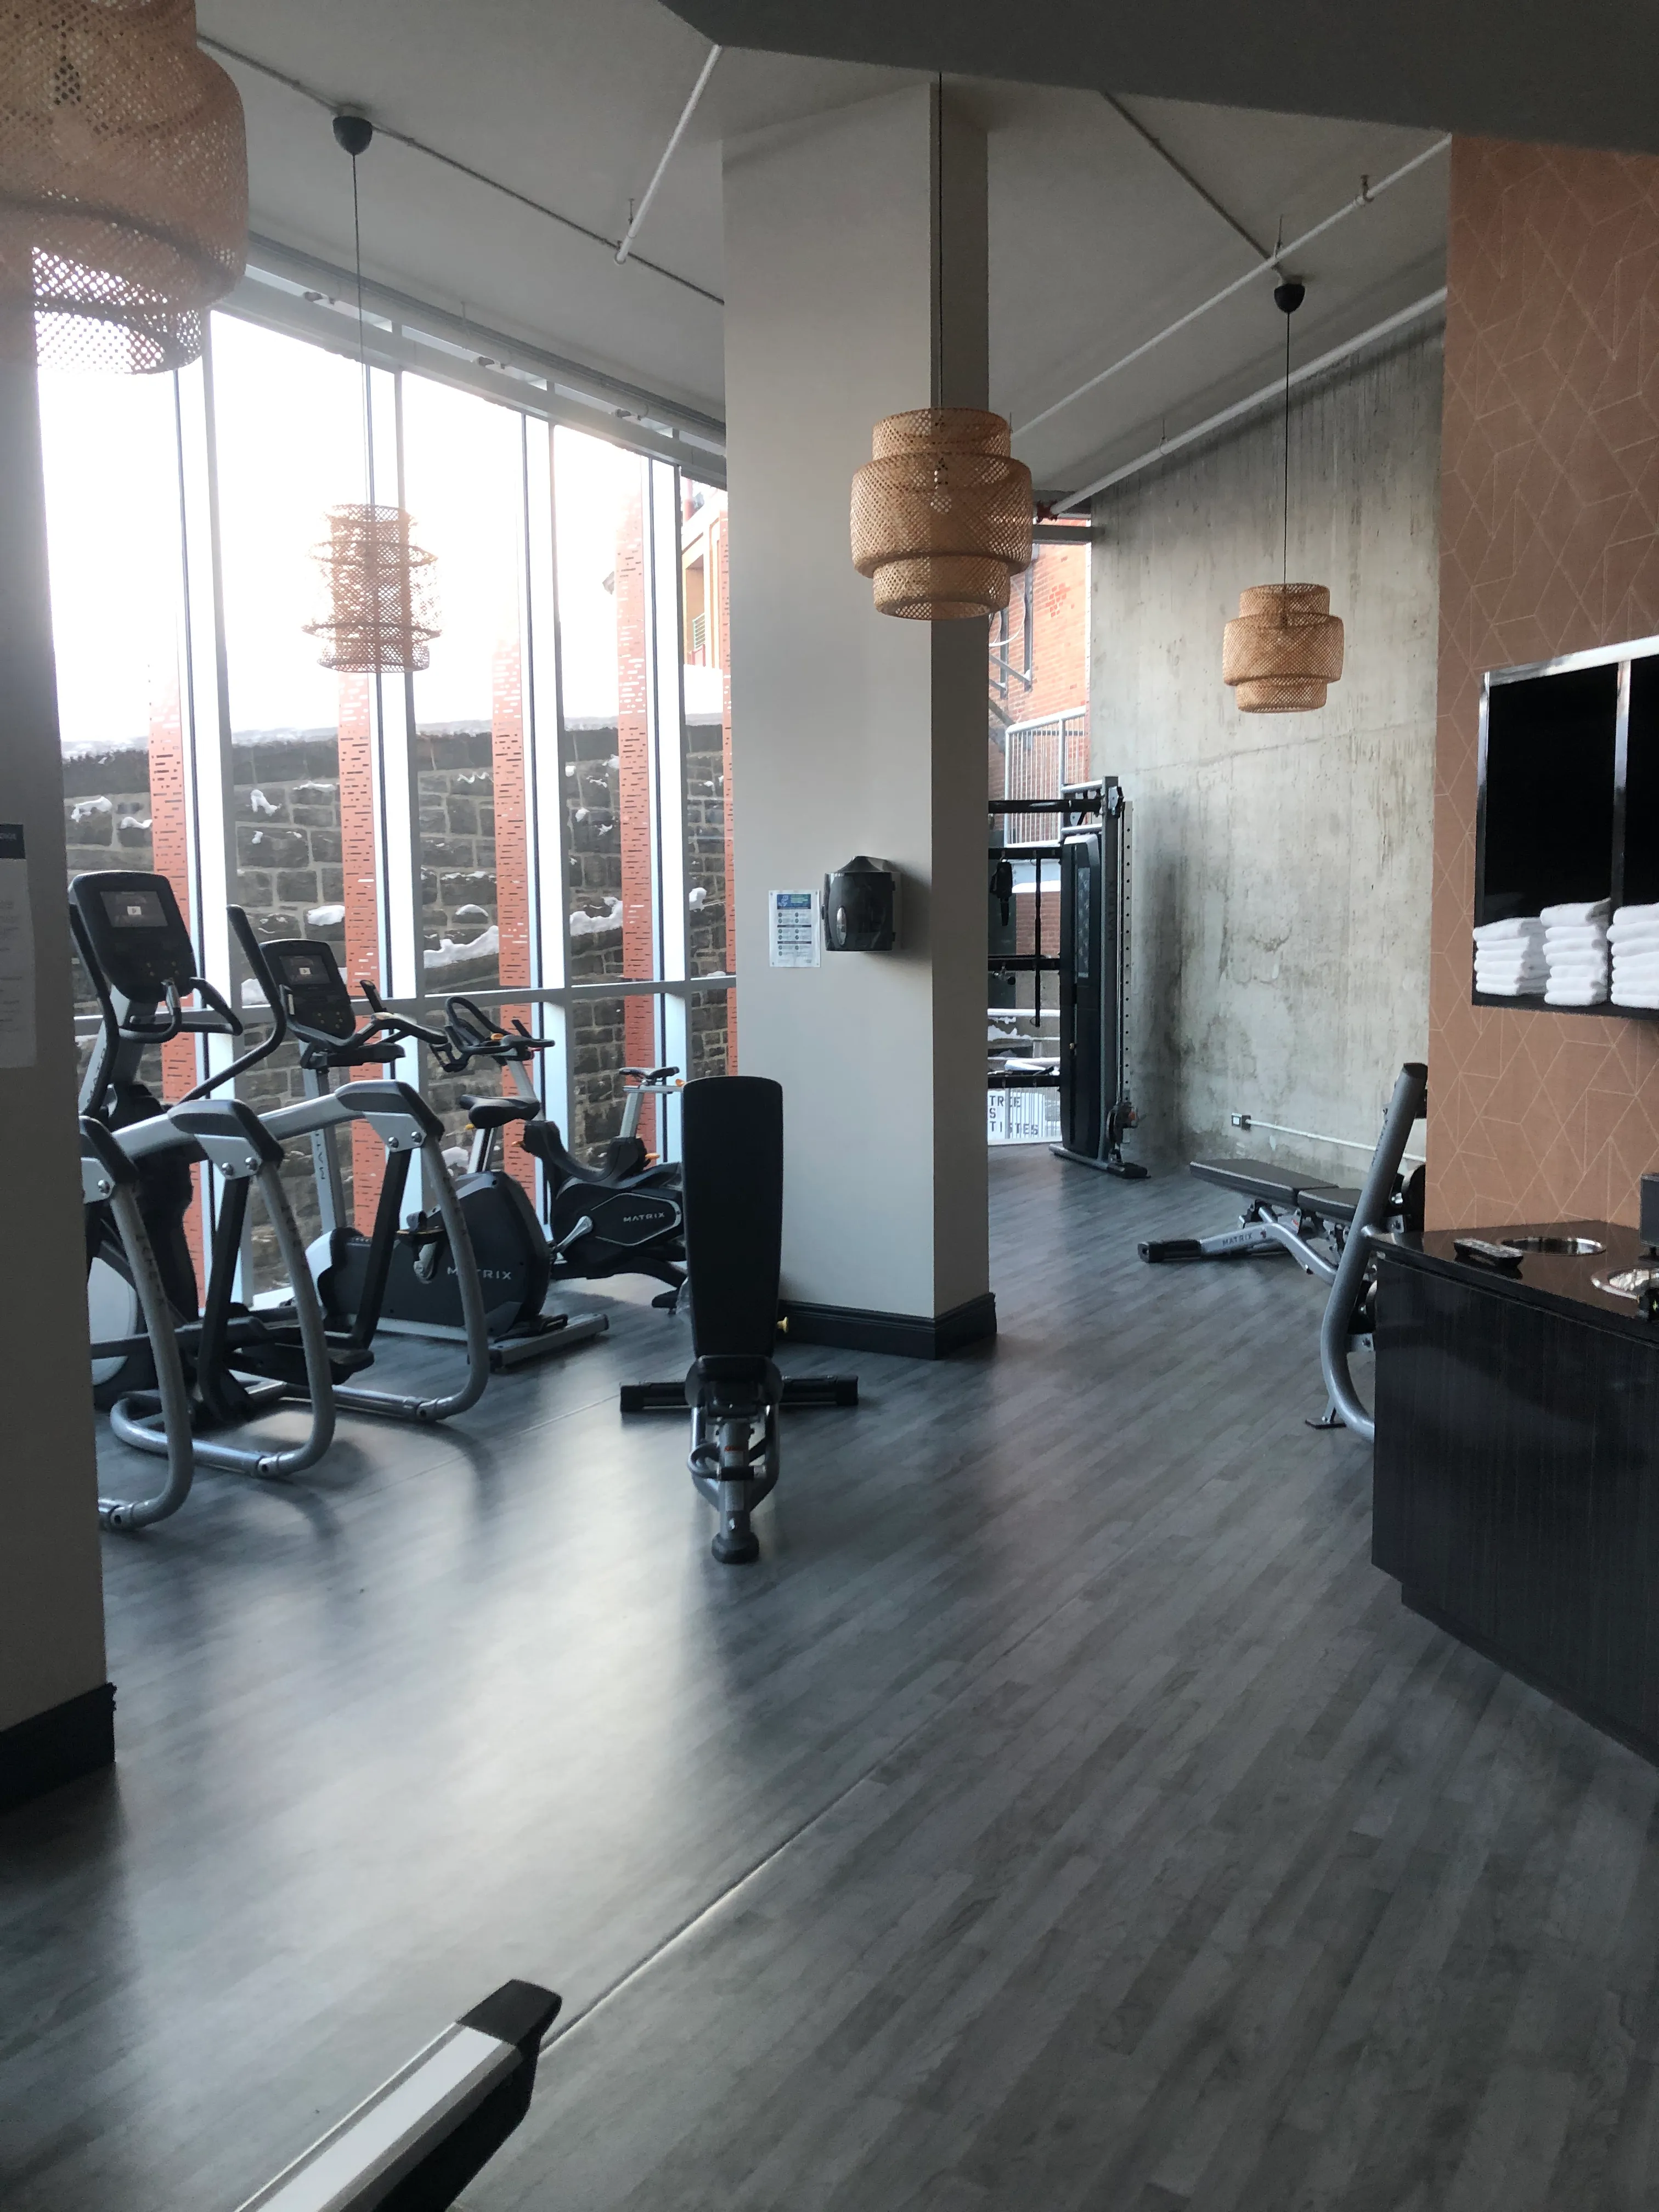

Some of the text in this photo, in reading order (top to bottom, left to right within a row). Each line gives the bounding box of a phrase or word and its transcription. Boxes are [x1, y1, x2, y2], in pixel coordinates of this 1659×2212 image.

[623, 1211, 665, 1223] MATRIX
[1222, 1232, 1252, 1245] MATRIX
[447, 1266, 512, 1280] MRIX
